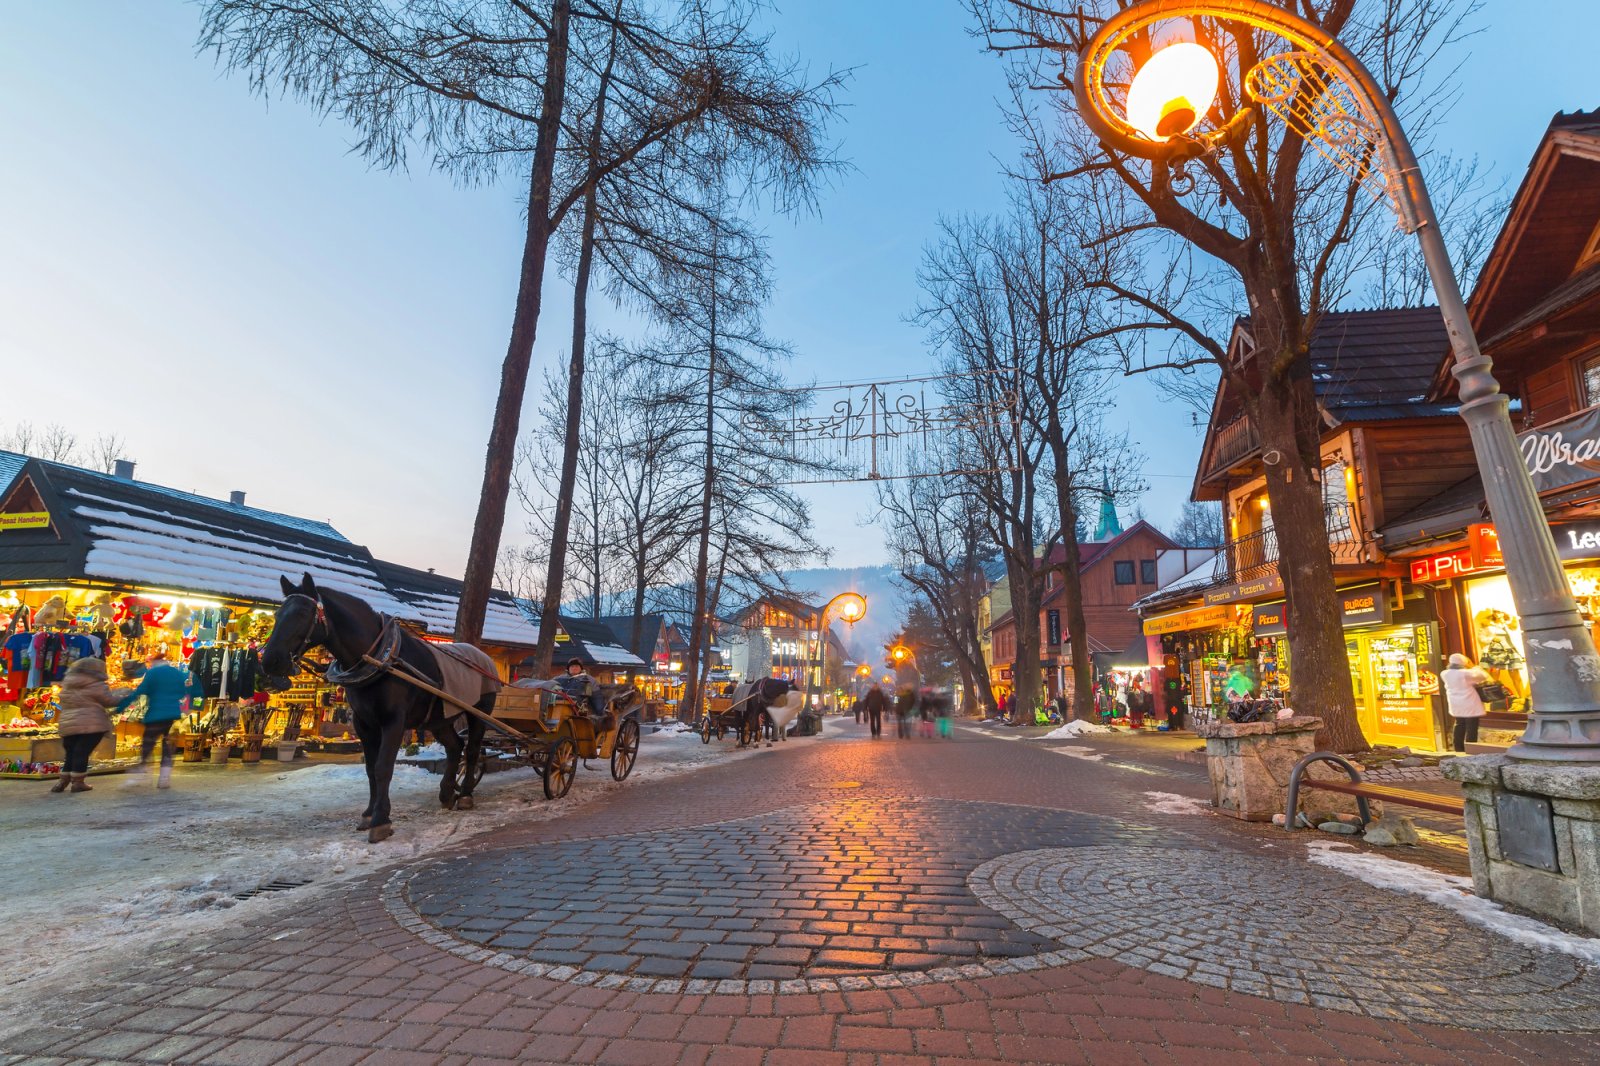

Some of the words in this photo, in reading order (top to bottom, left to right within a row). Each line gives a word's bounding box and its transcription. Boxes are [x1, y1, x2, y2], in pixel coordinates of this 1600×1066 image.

[1240, 582, 1265, 596] Pizzeria
[1344, 597, 1374, 610] BURGER
[1259, 614, 1279, 625] Pizza
[1416, 626, 1429, 664] Pizza
